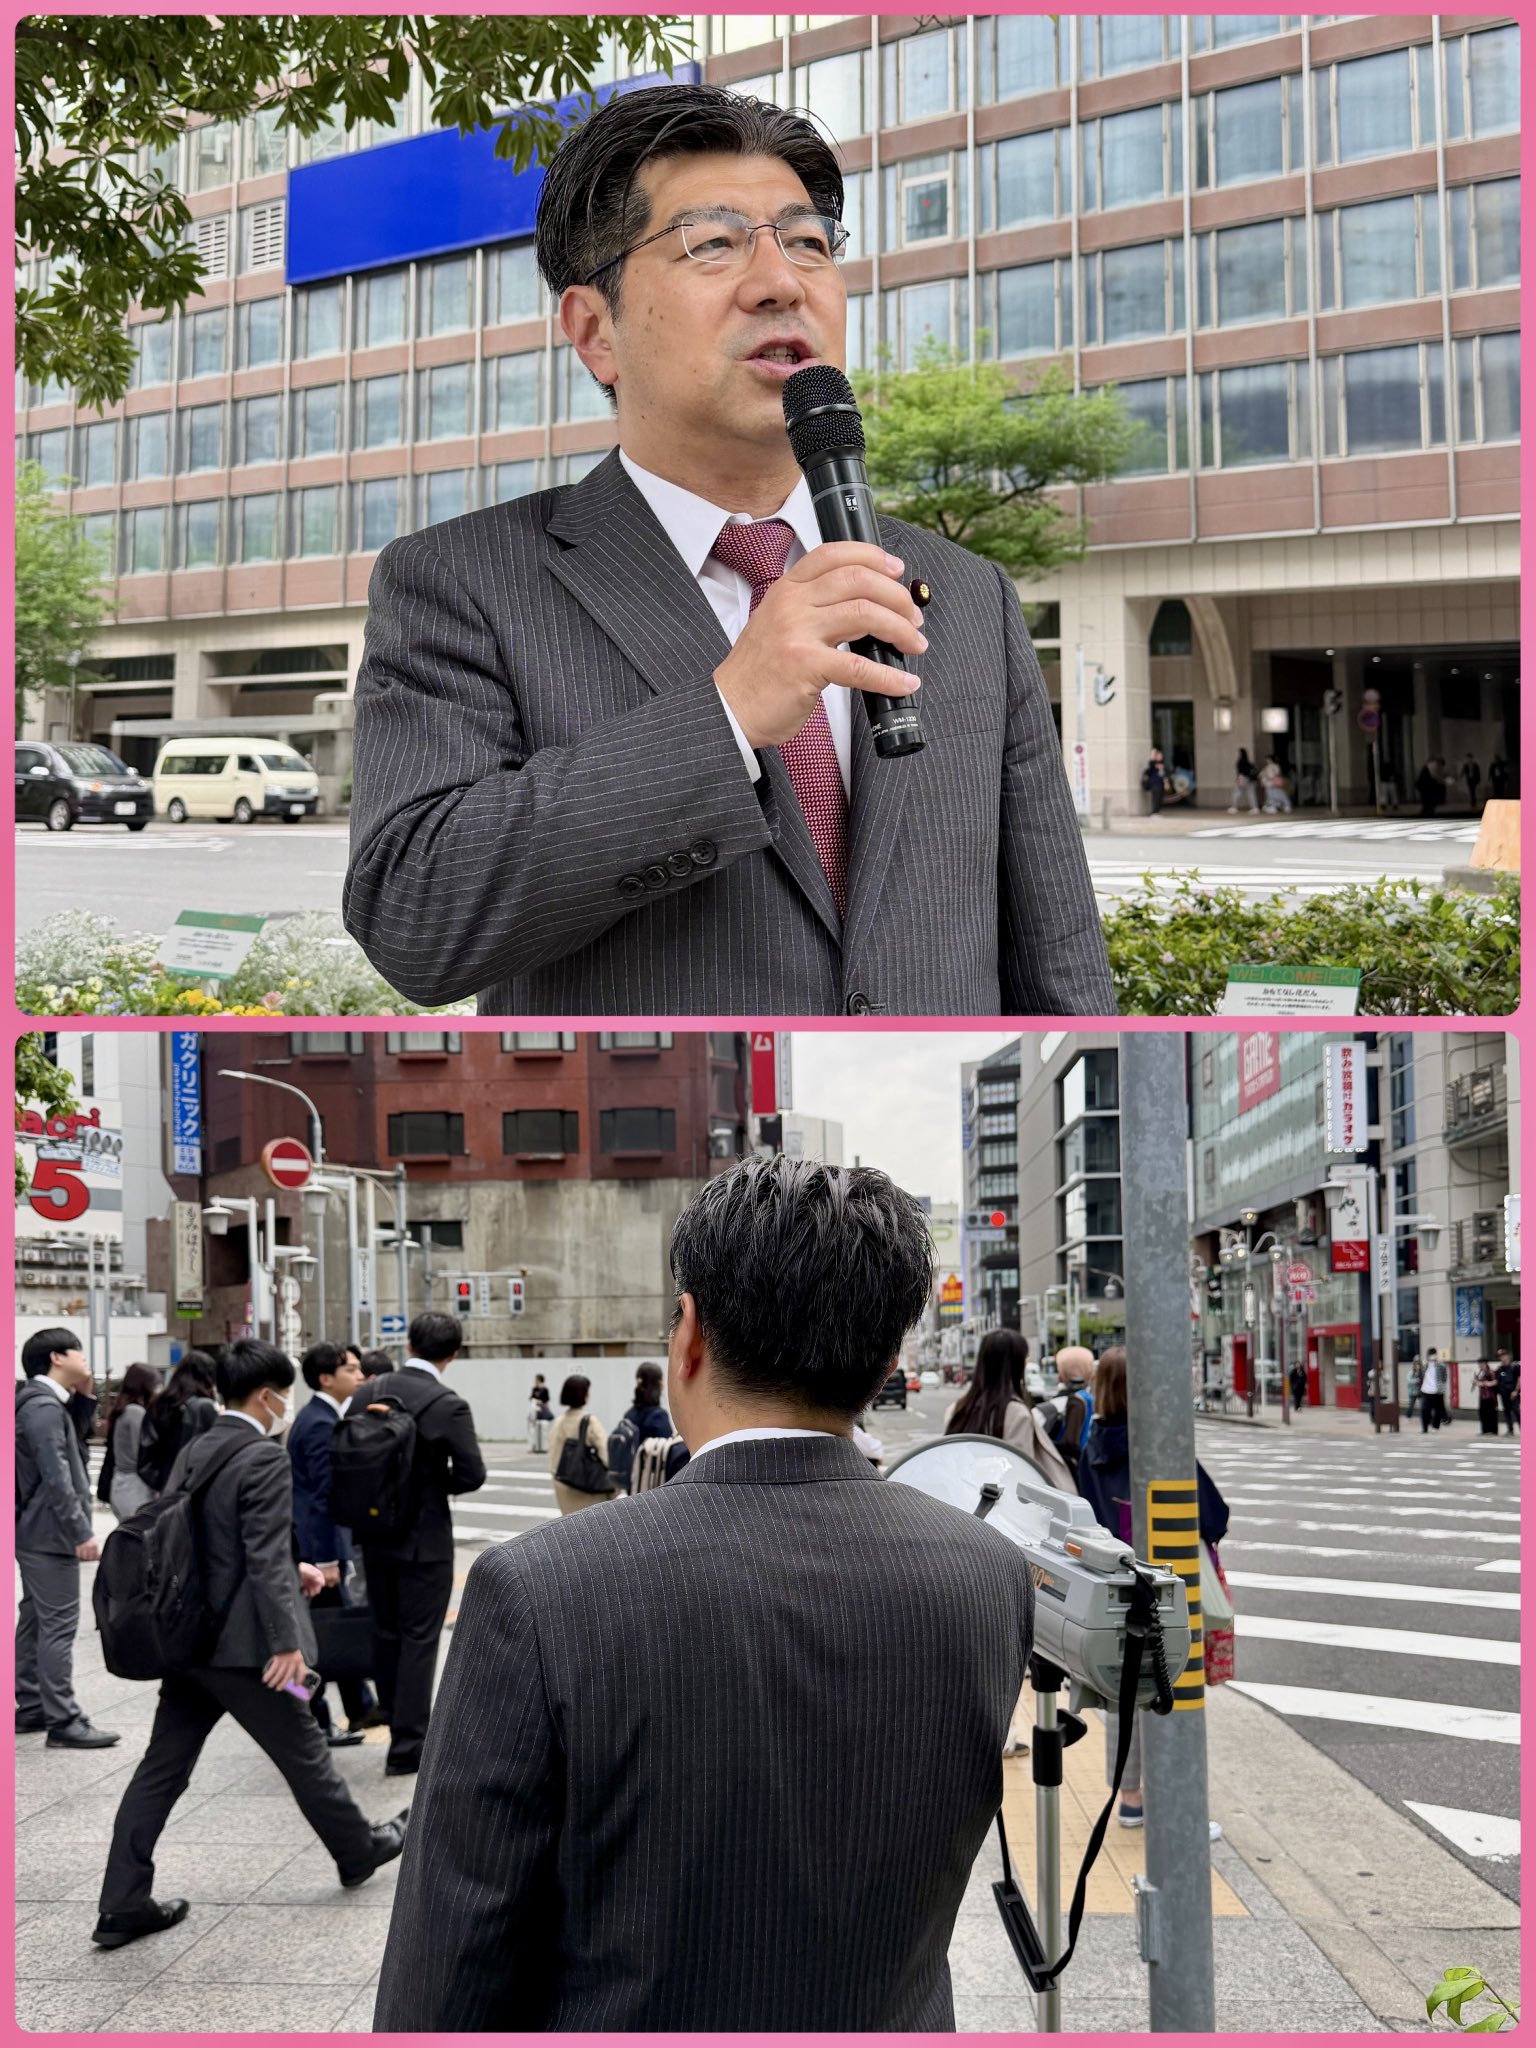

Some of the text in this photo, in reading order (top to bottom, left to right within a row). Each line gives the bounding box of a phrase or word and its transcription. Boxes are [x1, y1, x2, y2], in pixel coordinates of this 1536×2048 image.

[180, 1032, 199, 1136] ガクリニック
[29, 1157, 90, 1222] 5
